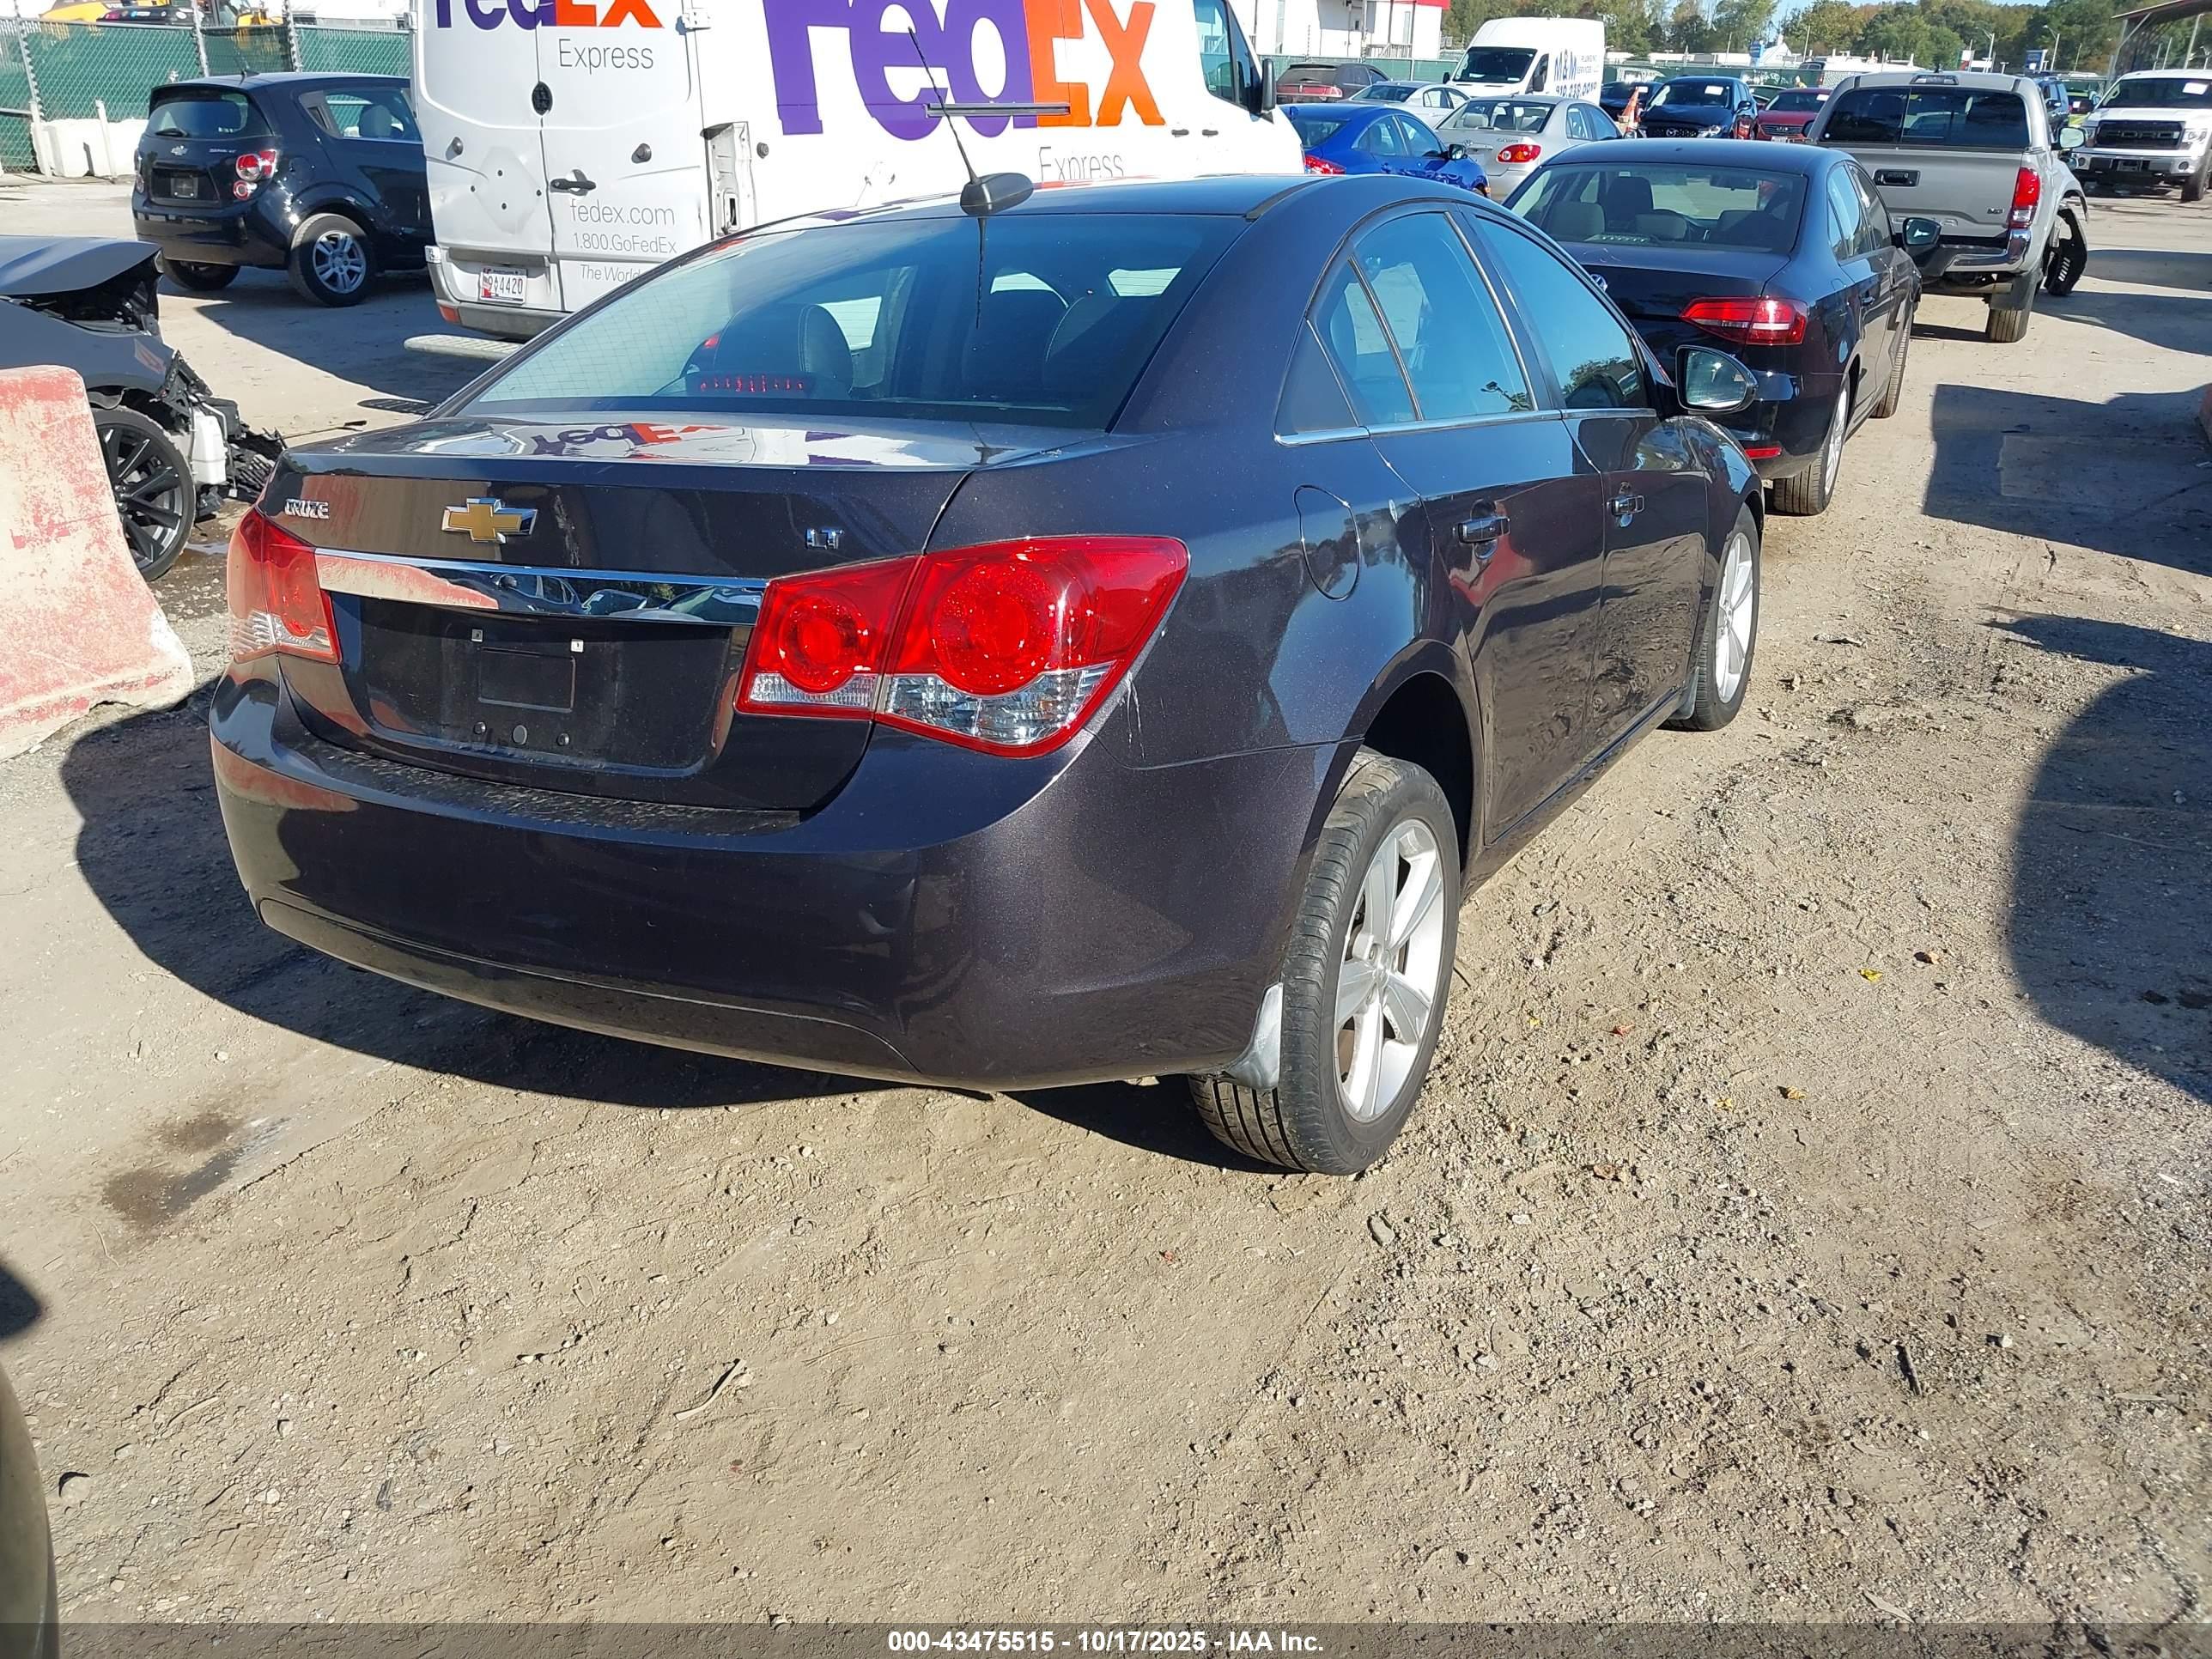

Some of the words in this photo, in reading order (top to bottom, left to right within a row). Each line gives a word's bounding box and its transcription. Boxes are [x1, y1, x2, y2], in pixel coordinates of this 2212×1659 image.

[559, 39, 653, 75] Express
[1554, 49, 1577, 82] M&M
[570, 198, 675, 226] fedex.com
[574, 232, 678, 253] 1.800.GoFedEx
[580, 264, 602, 281] The
[284, 498, 330, 520] CRUZE
[805, 528, 845, 550] LT
